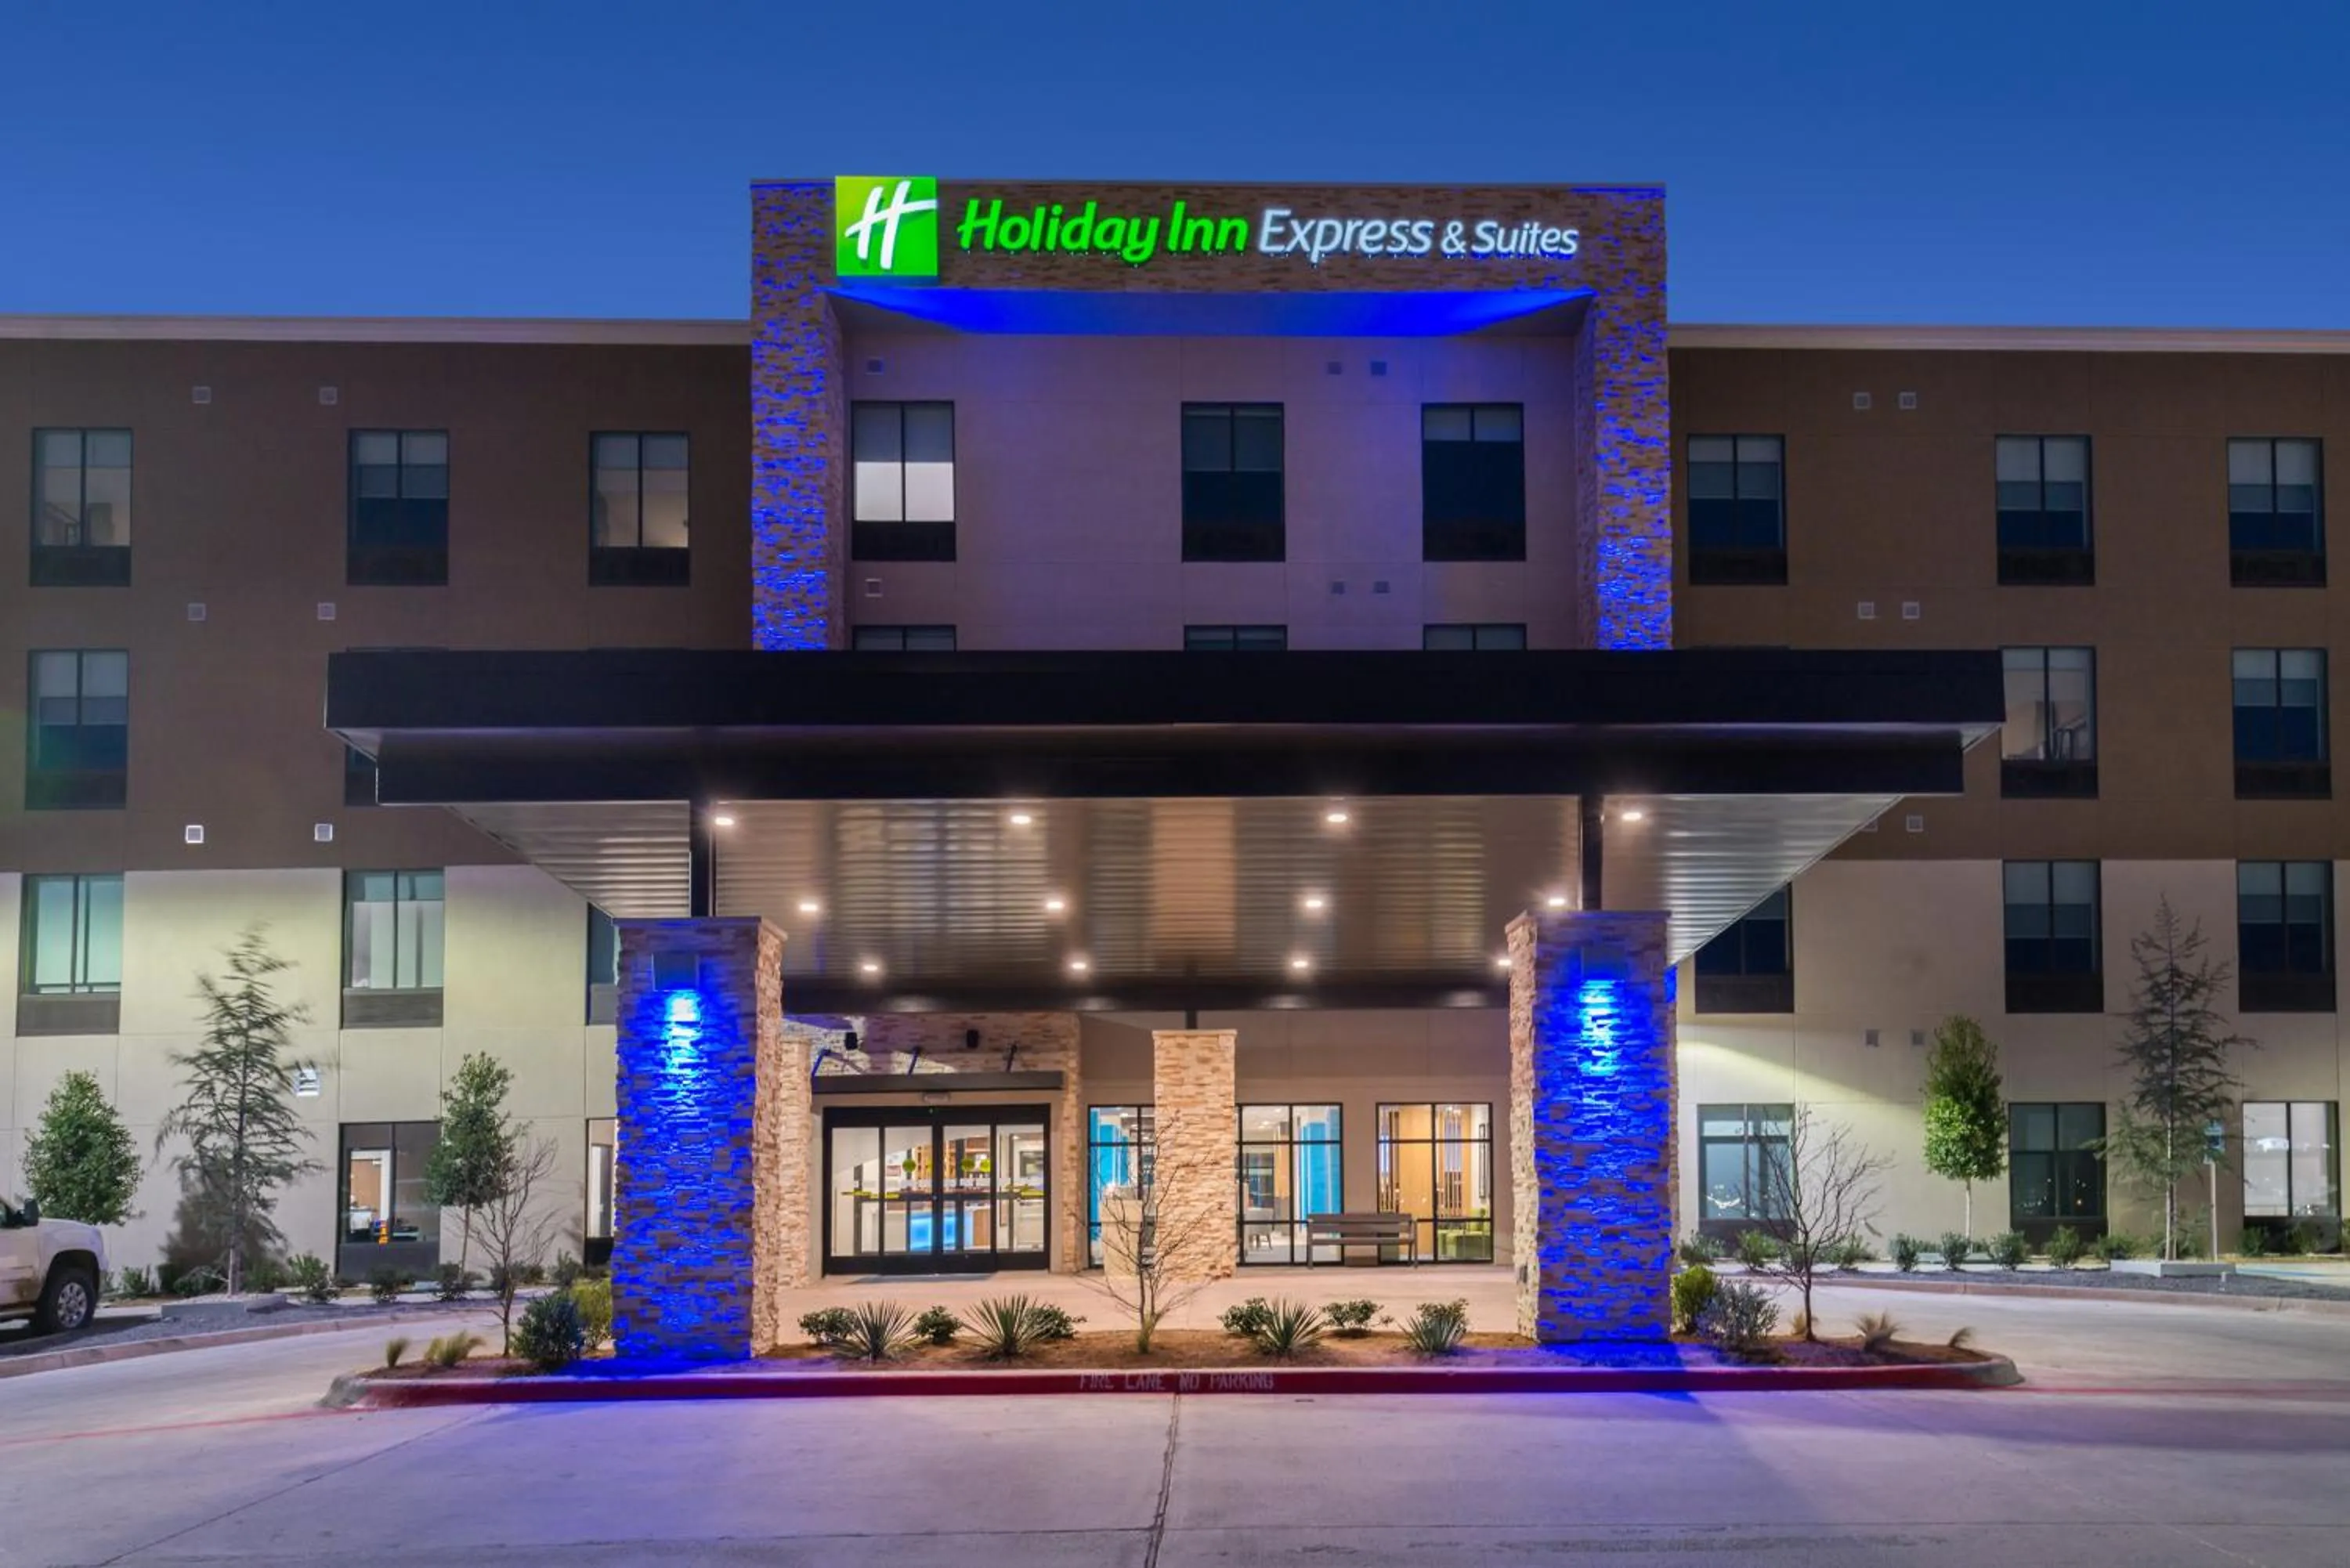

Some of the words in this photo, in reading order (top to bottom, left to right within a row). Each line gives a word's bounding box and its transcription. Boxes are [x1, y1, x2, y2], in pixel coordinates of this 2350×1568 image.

[956, 199, 1160, 262] Holiday
[1167, 201, 1249, 251] Inn
[1258, 208, 1435, 263] Express
[1441, 220, 1467, 254] &
[1471, 220, 1579, 255] Suites
[1079, 1372, 1114, 1390] FIRE
[1125, 1372, 1166, 1390] LANE
[1179, 1372, 1199, 1391] NO
[1209, 1372, 1274, 1389] PARKING
